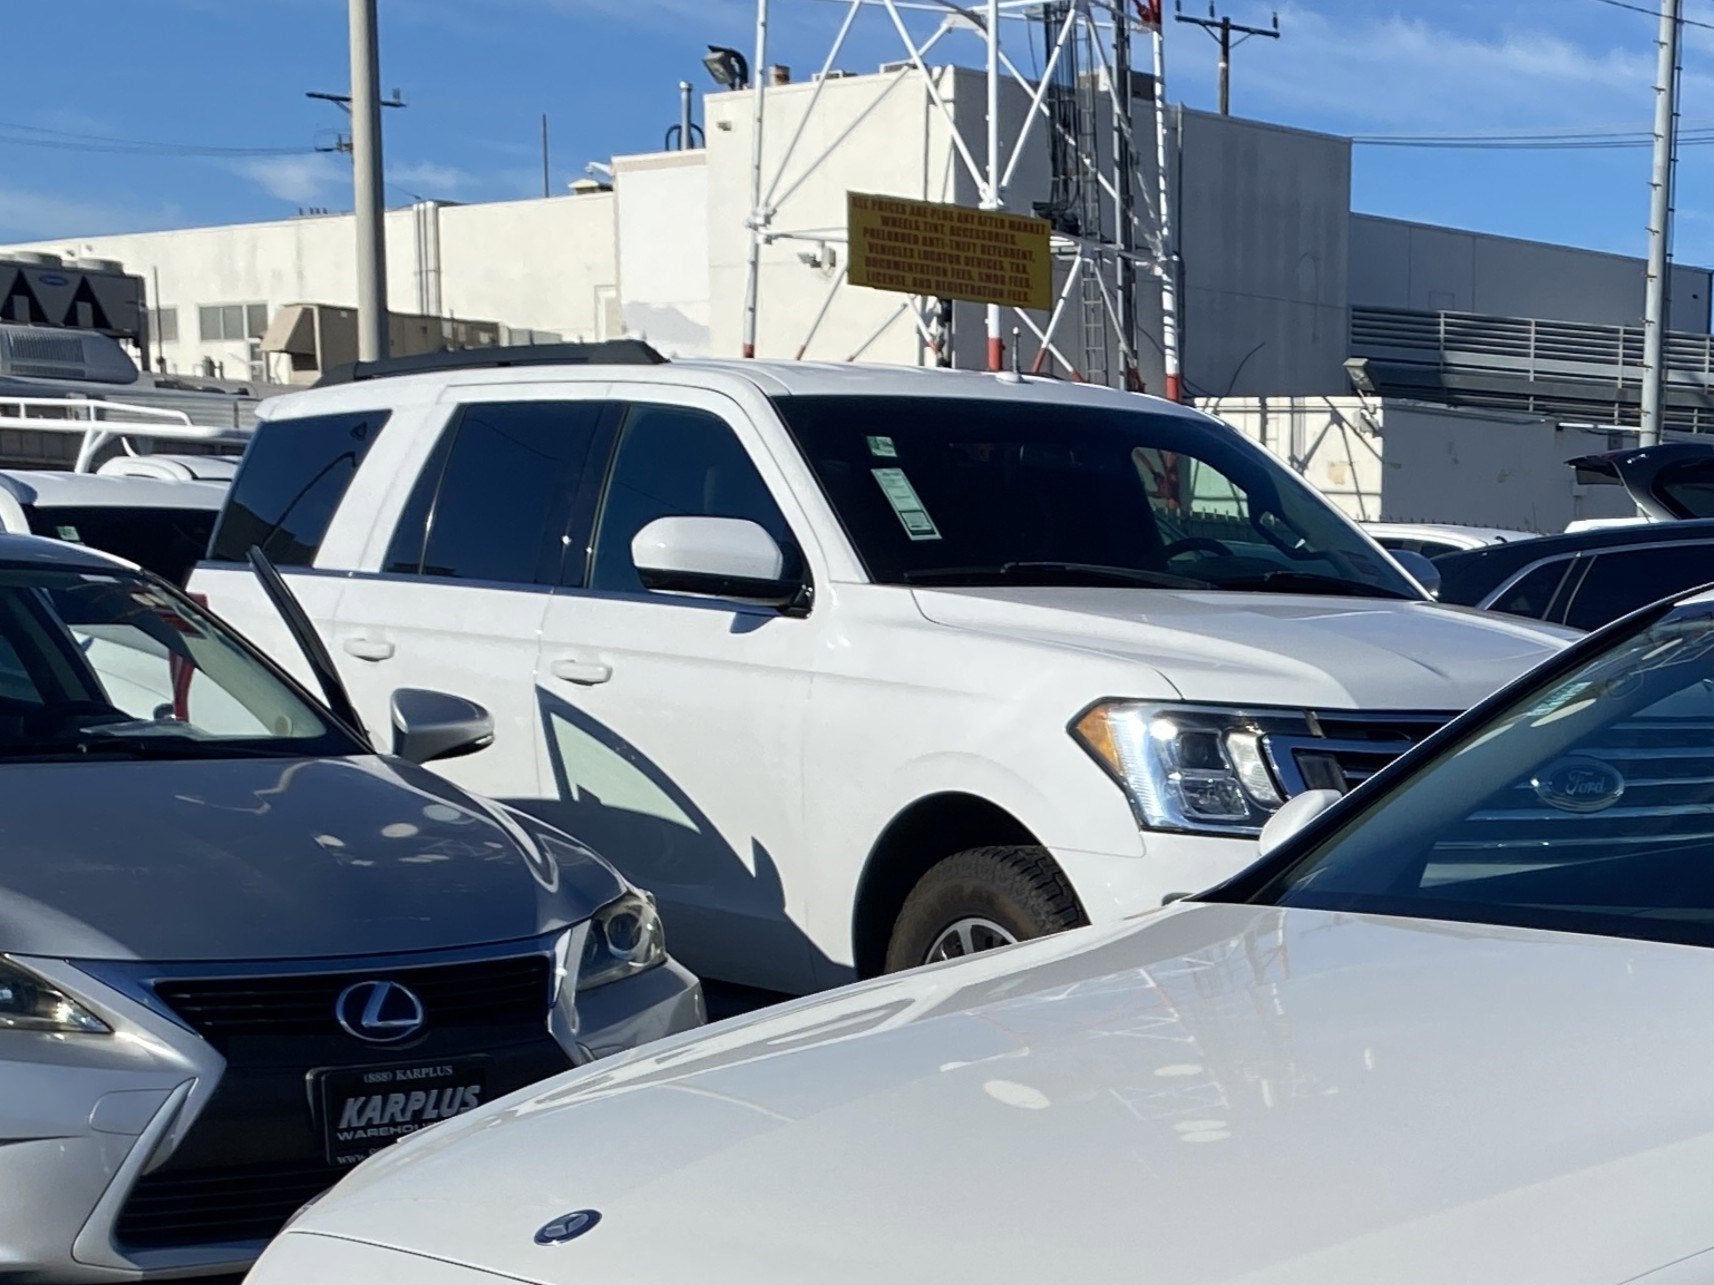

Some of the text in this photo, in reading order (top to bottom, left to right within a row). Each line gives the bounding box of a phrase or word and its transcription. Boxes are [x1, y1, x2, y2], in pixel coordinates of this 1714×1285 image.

[872, 200, 906, 215] PRICES
[910, 205, 928, 218] ARE
[930, 208, 953, 222] PLUS
[956, 212, 974, 225] ANY
[977, 214, 1005, 229] AFTER
[1008, 219, 1045, 235] MARKET
[917, 249, 960, 264] LOCATOR
[865, 256, 947, 277] DOCUMENTATION
[979, 271, 1005, 285] SMOG
[912, 277, 931, 289] AND
[935, 280, 1003, 299] REGISTRATION
[1565, 770, 1606, 796] Ford
[364, 1065, 454, 1084] (888) KARPLUS
[337, 1084, 481, 1129] KARPLUS
